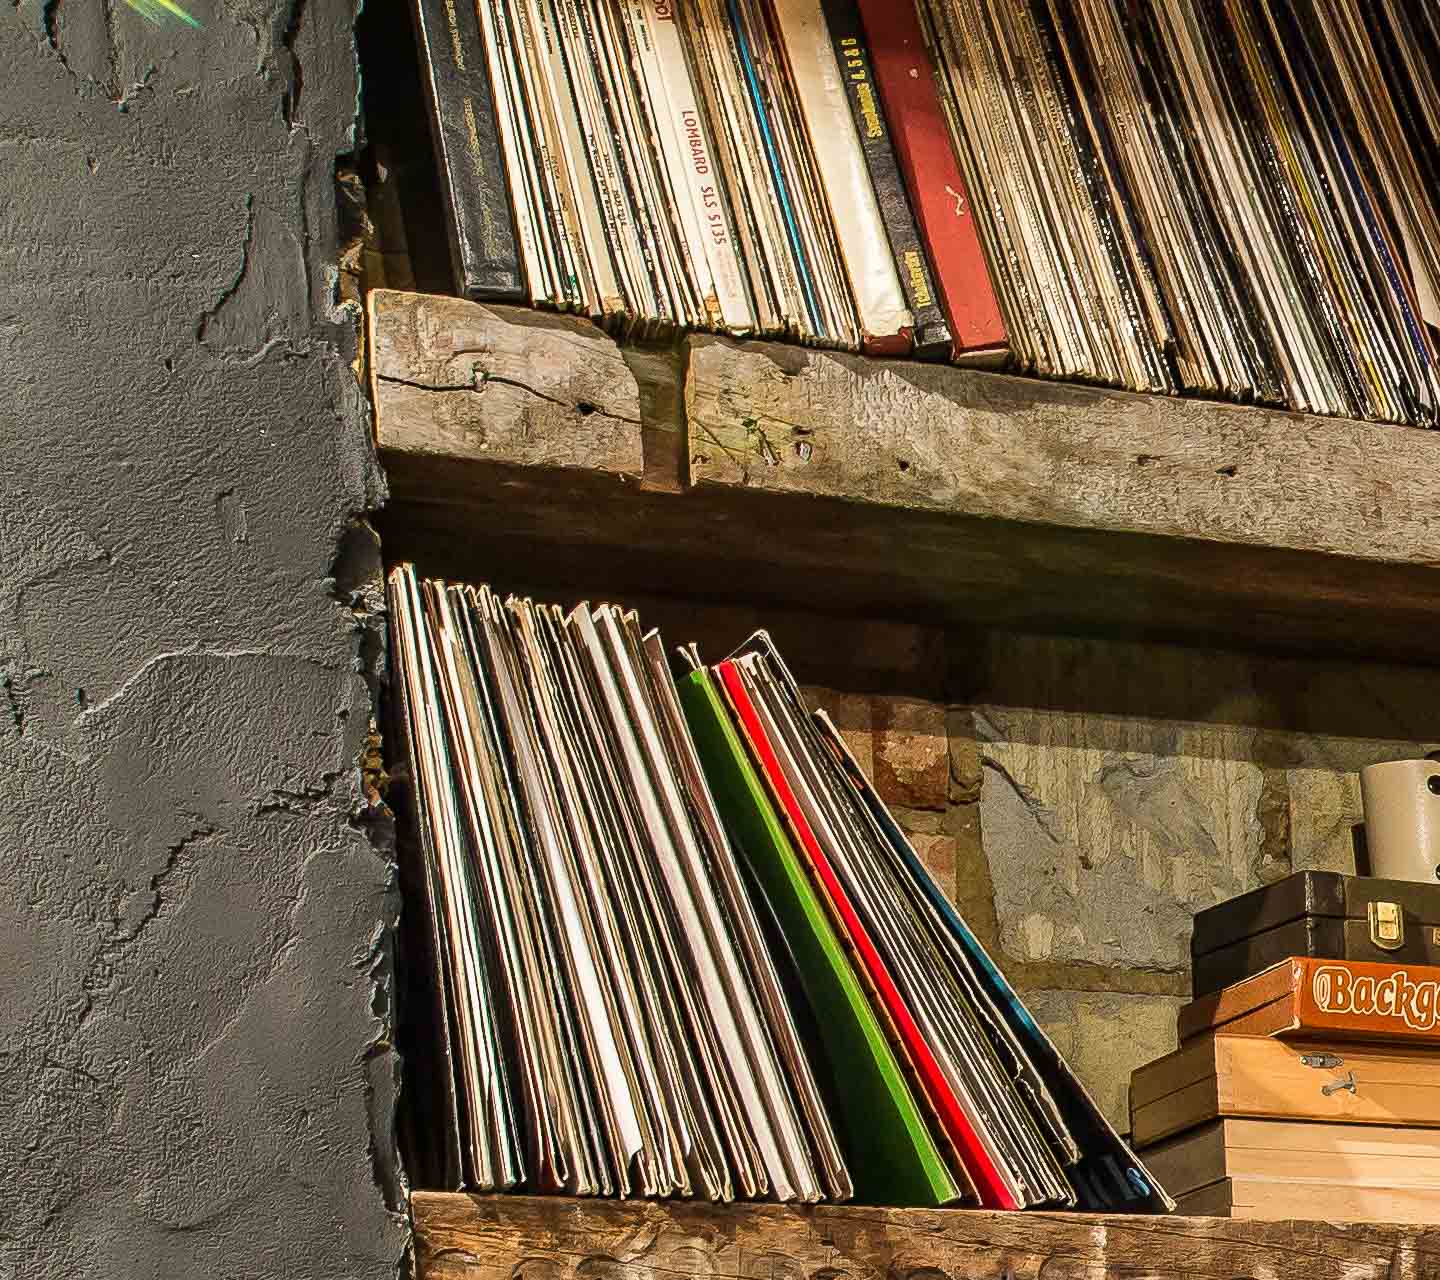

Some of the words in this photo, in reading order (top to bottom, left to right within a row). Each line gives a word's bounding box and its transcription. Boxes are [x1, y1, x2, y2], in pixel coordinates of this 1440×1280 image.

[680, 109, 709, 175] LOMBARD
[701, 185, 718, 208] SLS
[708, 212, 727, 246] 5135
